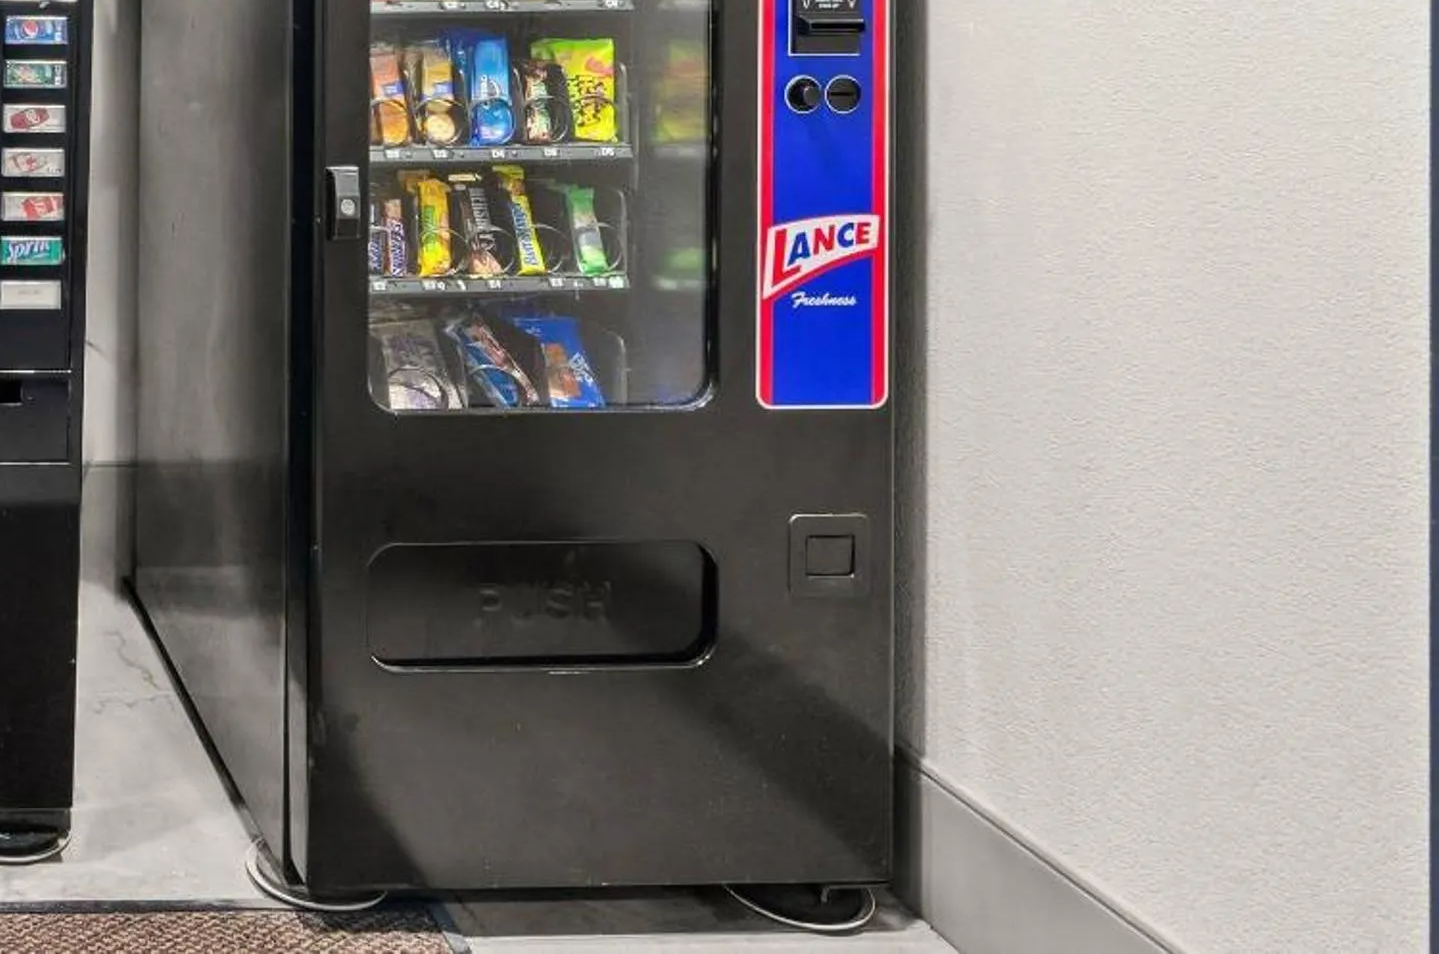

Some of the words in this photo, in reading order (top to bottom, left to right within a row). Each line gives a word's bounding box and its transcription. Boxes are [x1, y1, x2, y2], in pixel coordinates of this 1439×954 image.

[771, 221, 872, 288] LANCE
[791, 291, 857, 308] Freshness
[474, 582, 612, 628] PUSH
